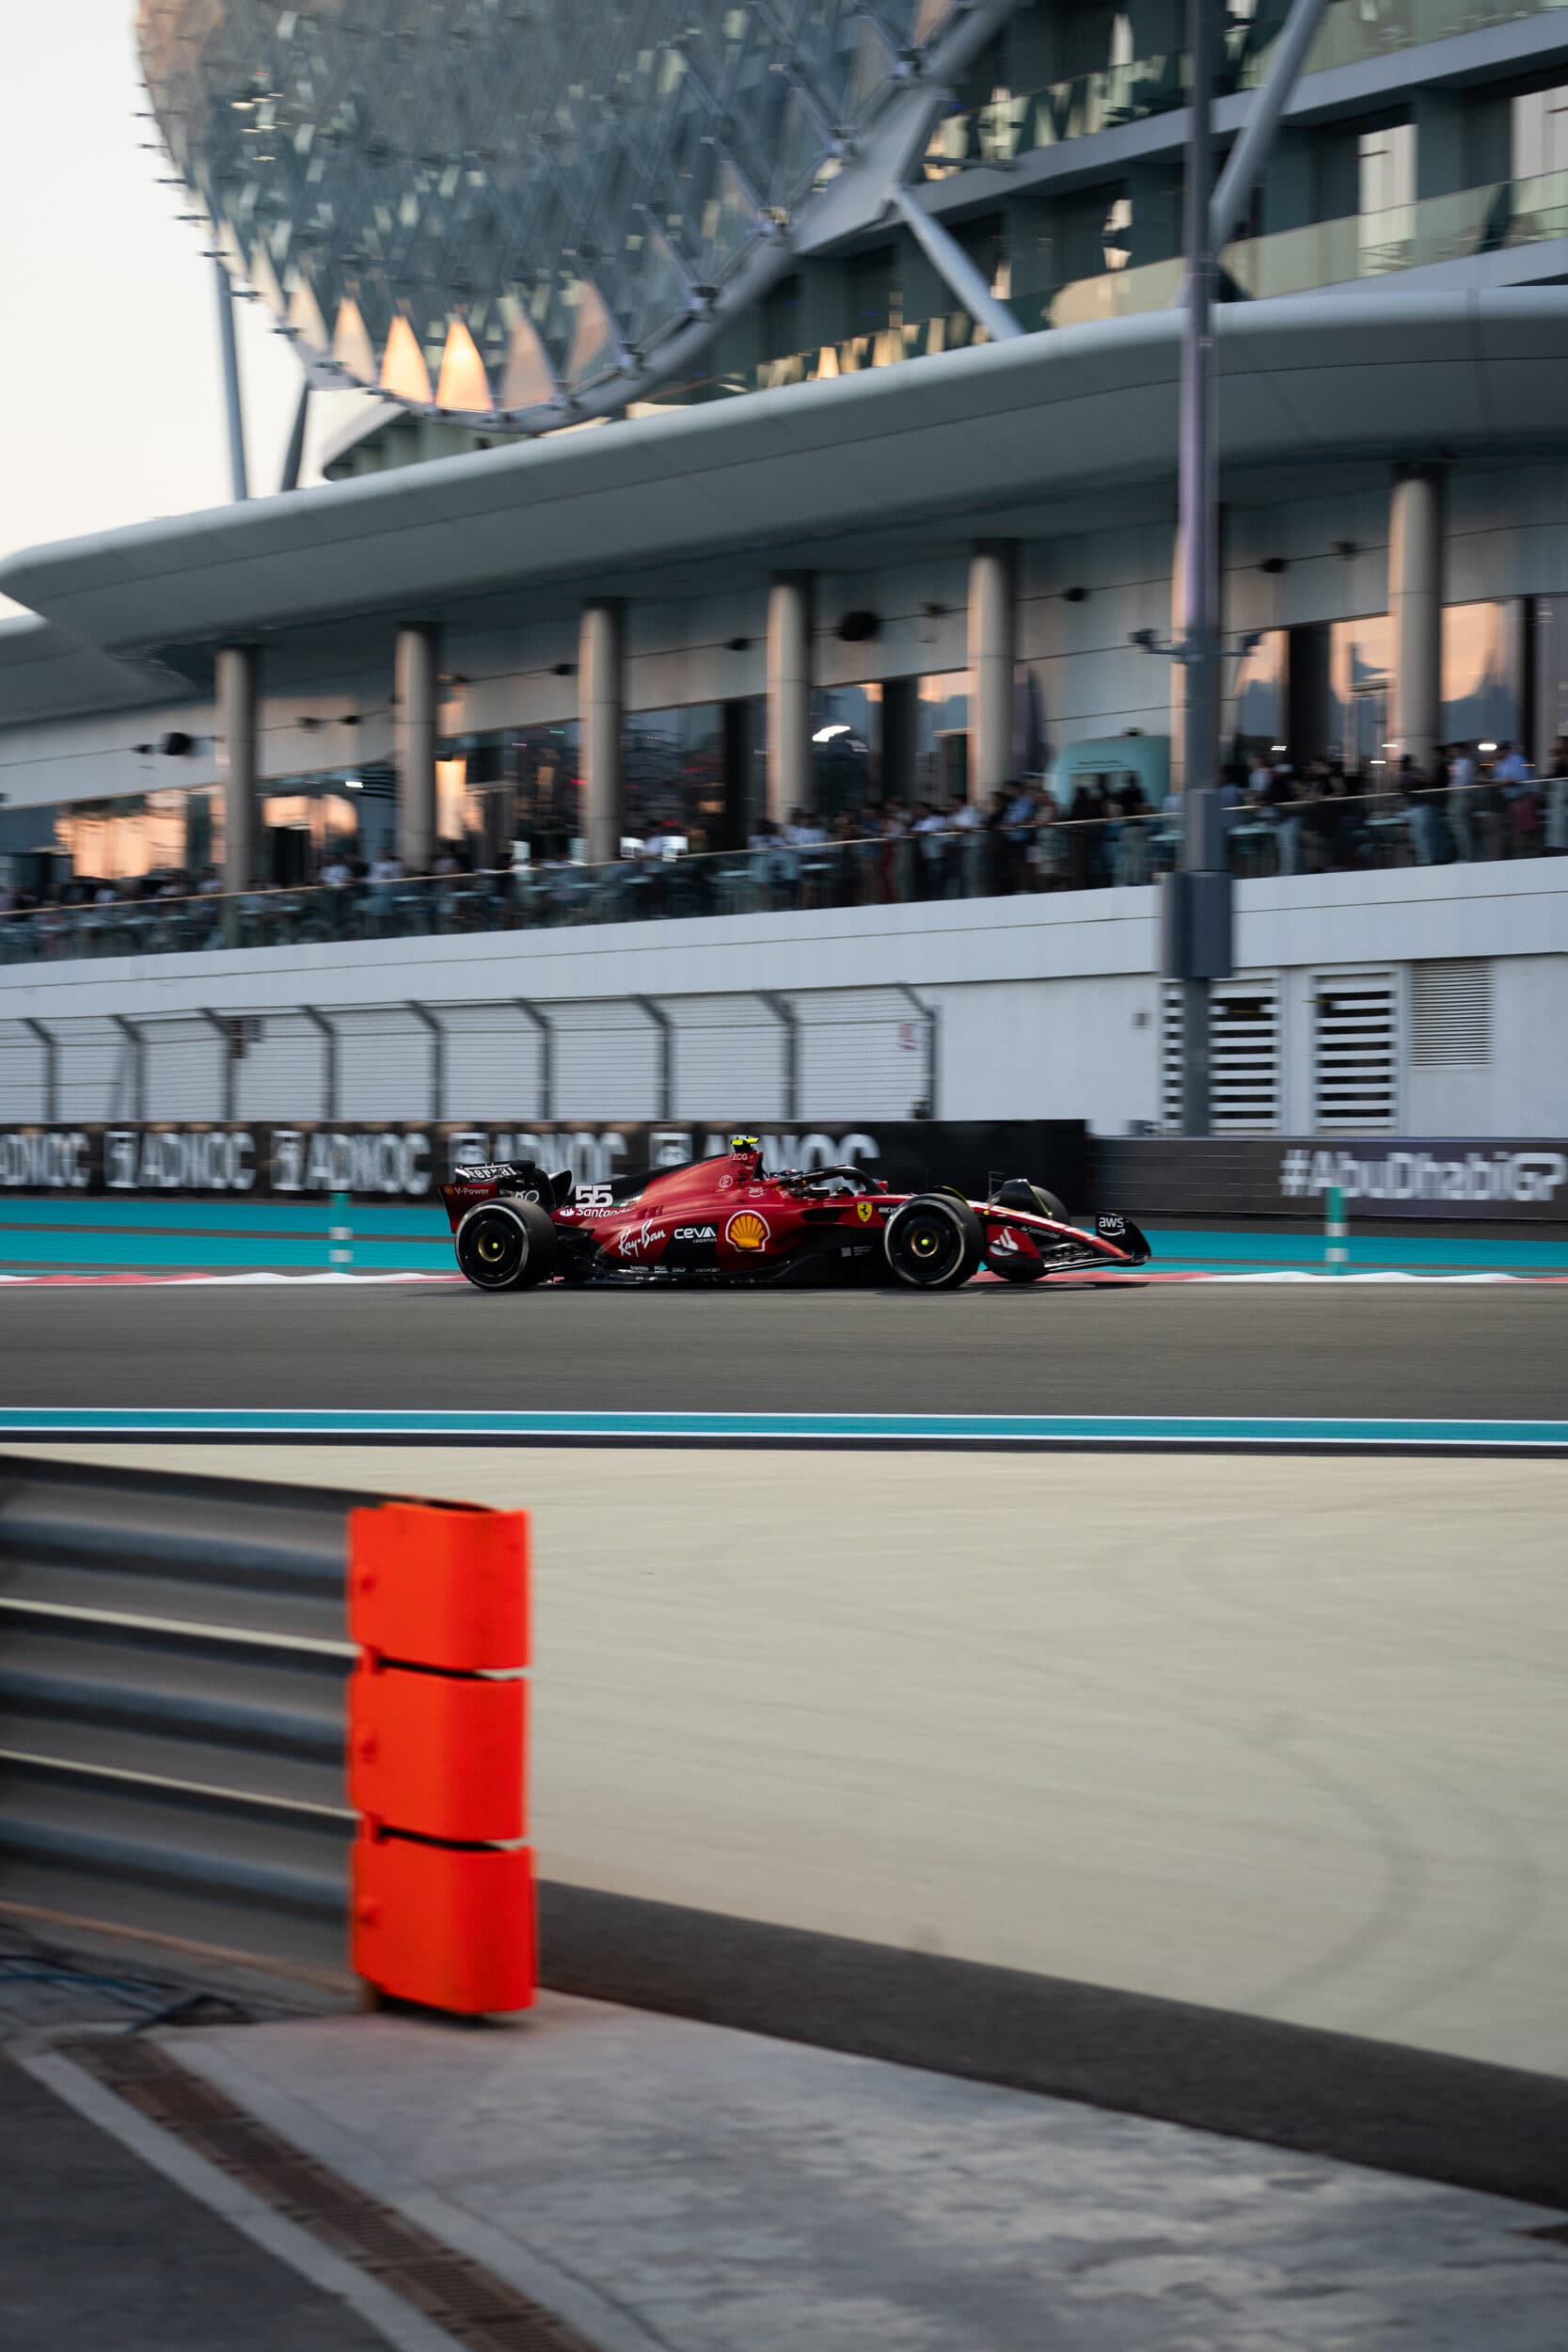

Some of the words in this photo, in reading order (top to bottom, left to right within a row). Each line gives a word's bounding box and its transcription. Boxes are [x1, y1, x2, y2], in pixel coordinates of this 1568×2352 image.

[141, 1132, 256, 1189] ADNOC
[306, 1133, 432, 1194] ADNOC
[732, 1152, 749, 1161] ZCG
[454, 1186, 489, 1195] V-Power
[575, 1184, 613, 1208] 55
[1099, 1216, 1125, 1228] aws
[618, 1218, 667, 1258] Ray-Ban
[673, 1226, 717, 1239] CEVA
